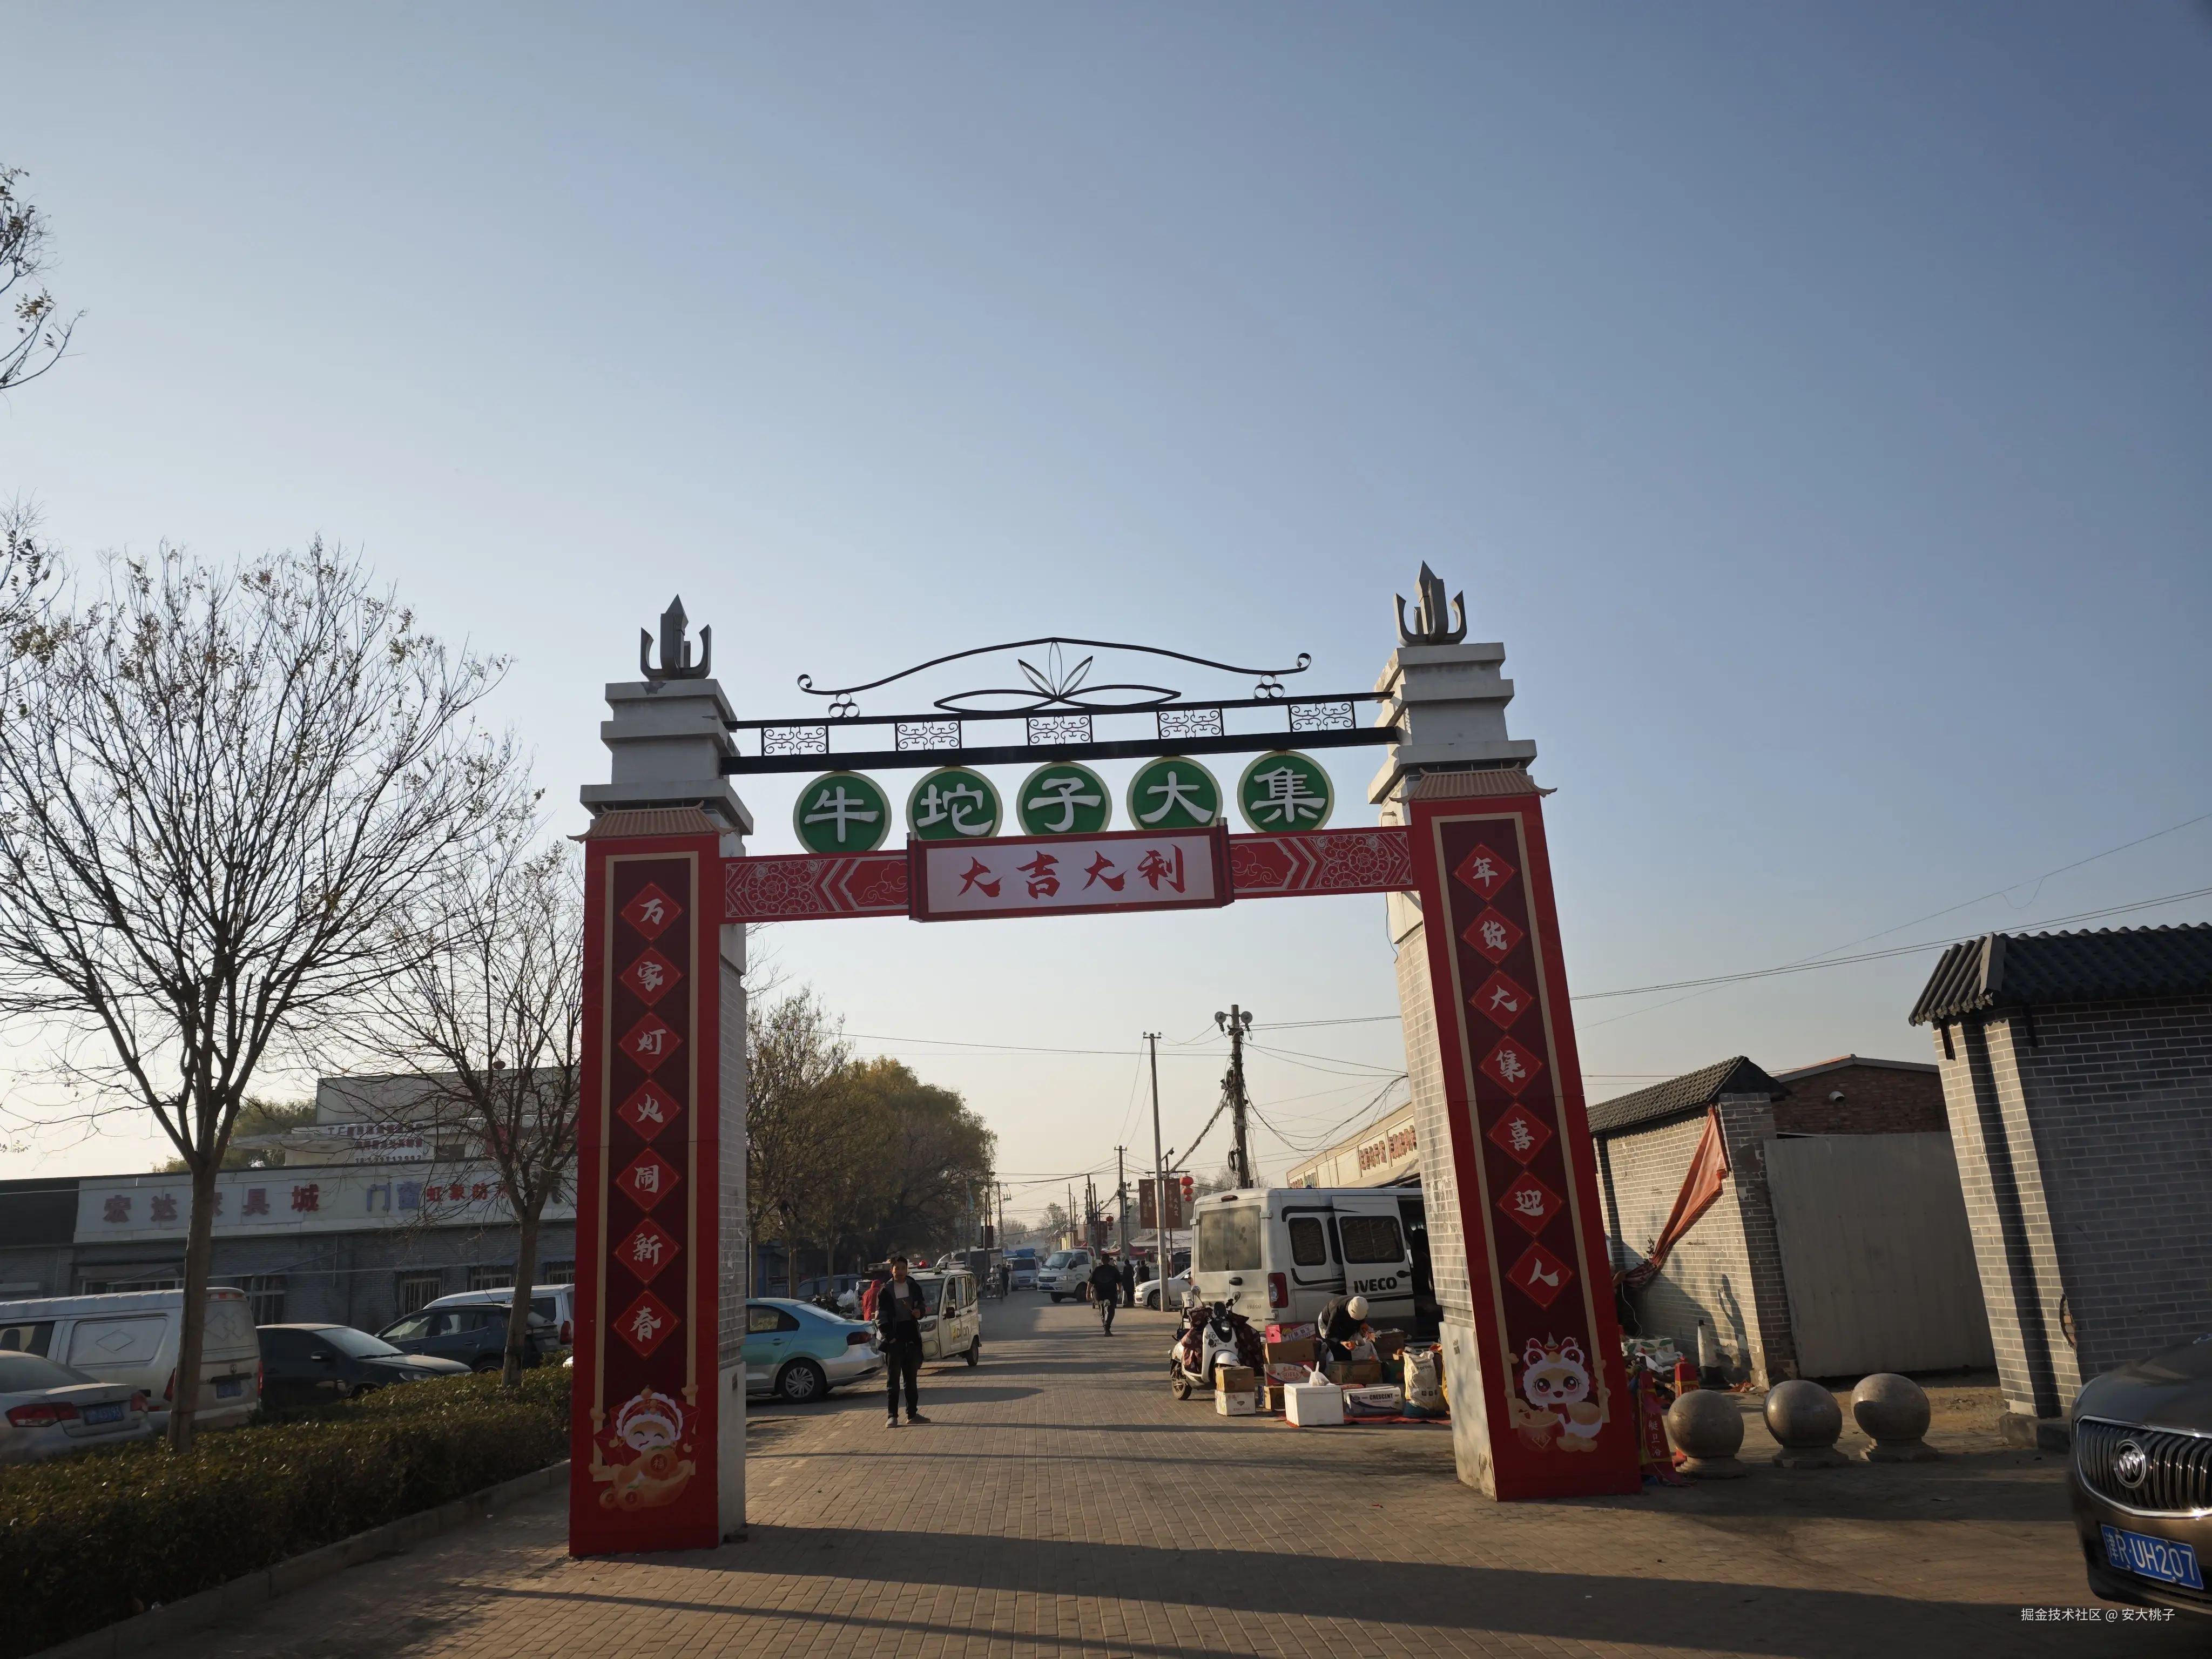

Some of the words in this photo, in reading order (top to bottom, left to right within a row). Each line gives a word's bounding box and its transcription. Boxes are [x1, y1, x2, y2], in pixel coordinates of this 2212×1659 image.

[804, 766, 1327, 844] 牛坨子大集
[956, 842, 1186, 900] 大吉大利
[1472, 856, 1560, 1287] 年货大集喜迎人
[630, 898, 667, 1343] 万家灯火闹新春
[1353, 1277, 1398, 1293] IVECO
[652, 1458, 665, 1469] 福
